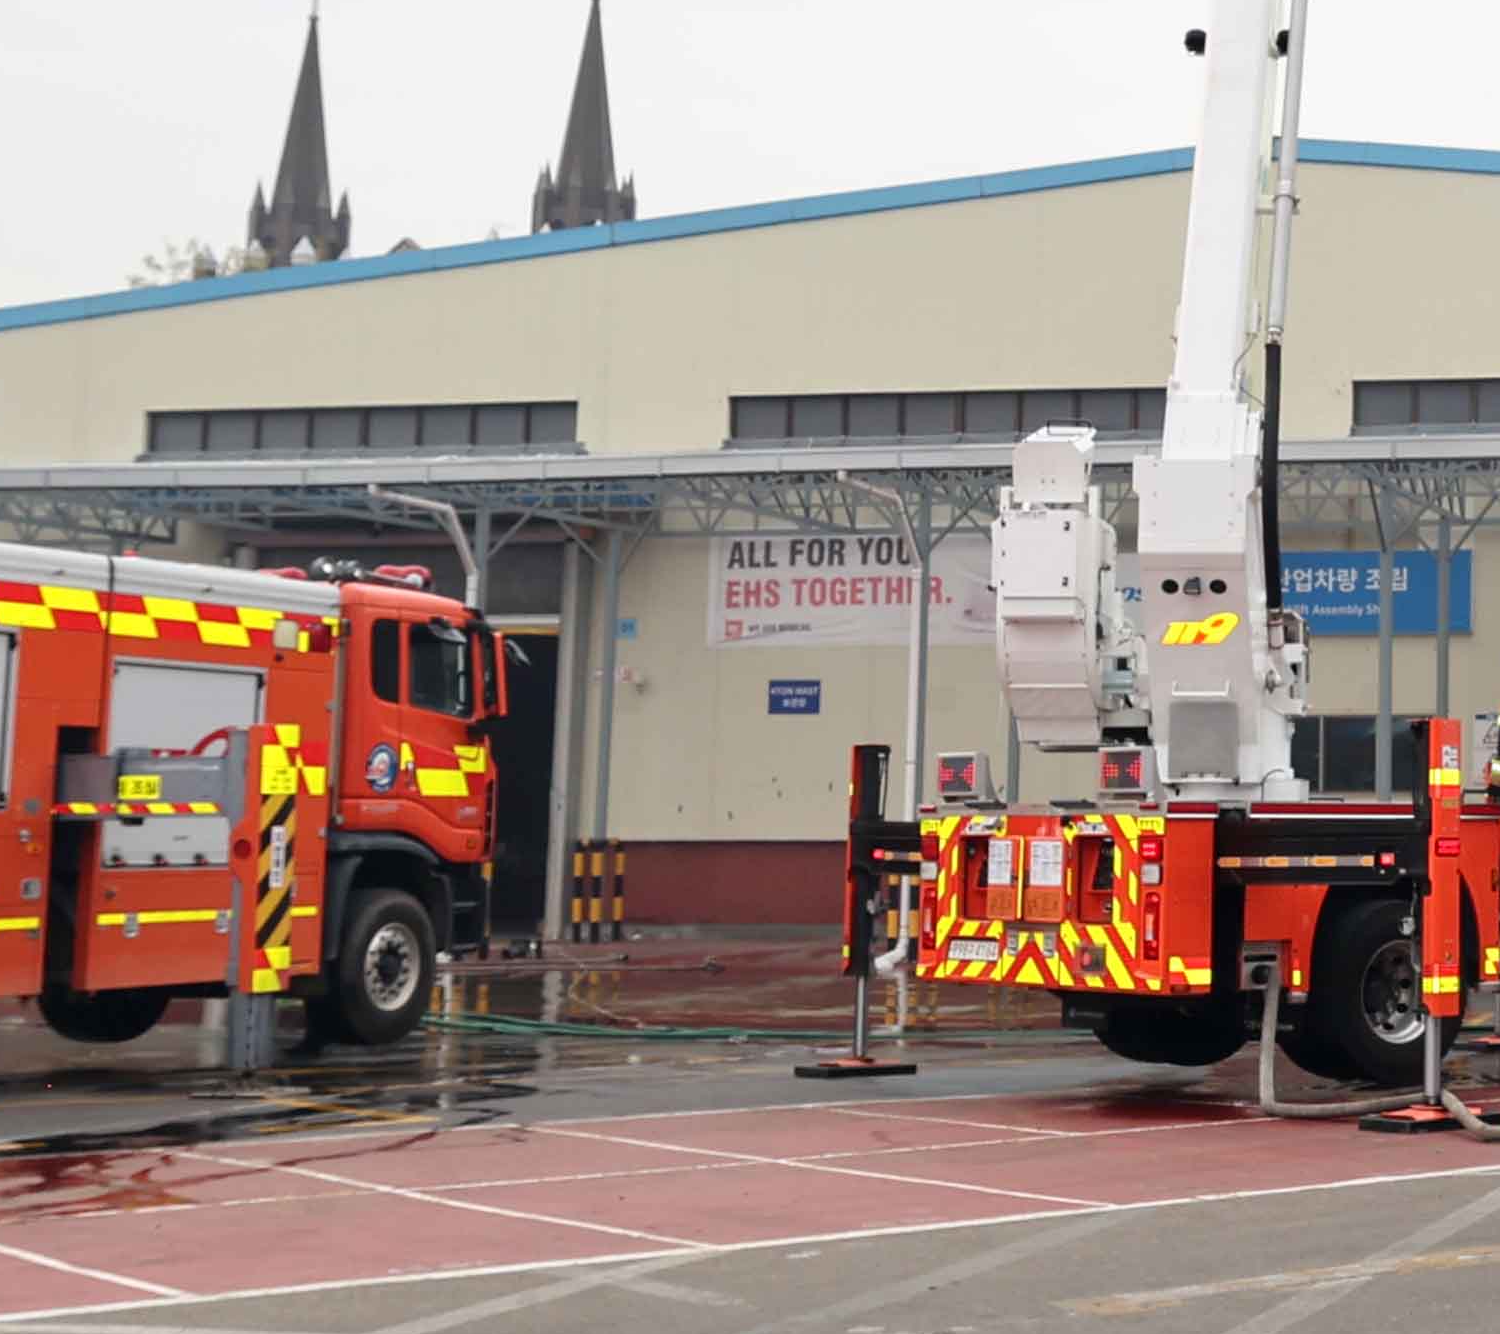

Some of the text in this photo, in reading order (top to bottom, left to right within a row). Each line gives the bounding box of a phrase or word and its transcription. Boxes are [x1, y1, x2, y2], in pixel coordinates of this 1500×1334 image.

[727, 540, 778, 569] ALL
[789, 538, 845, 566] FOR
[725, 575, 952, 609] EHS TOGETHR.
[1161, 611, 1239, 645] 119
